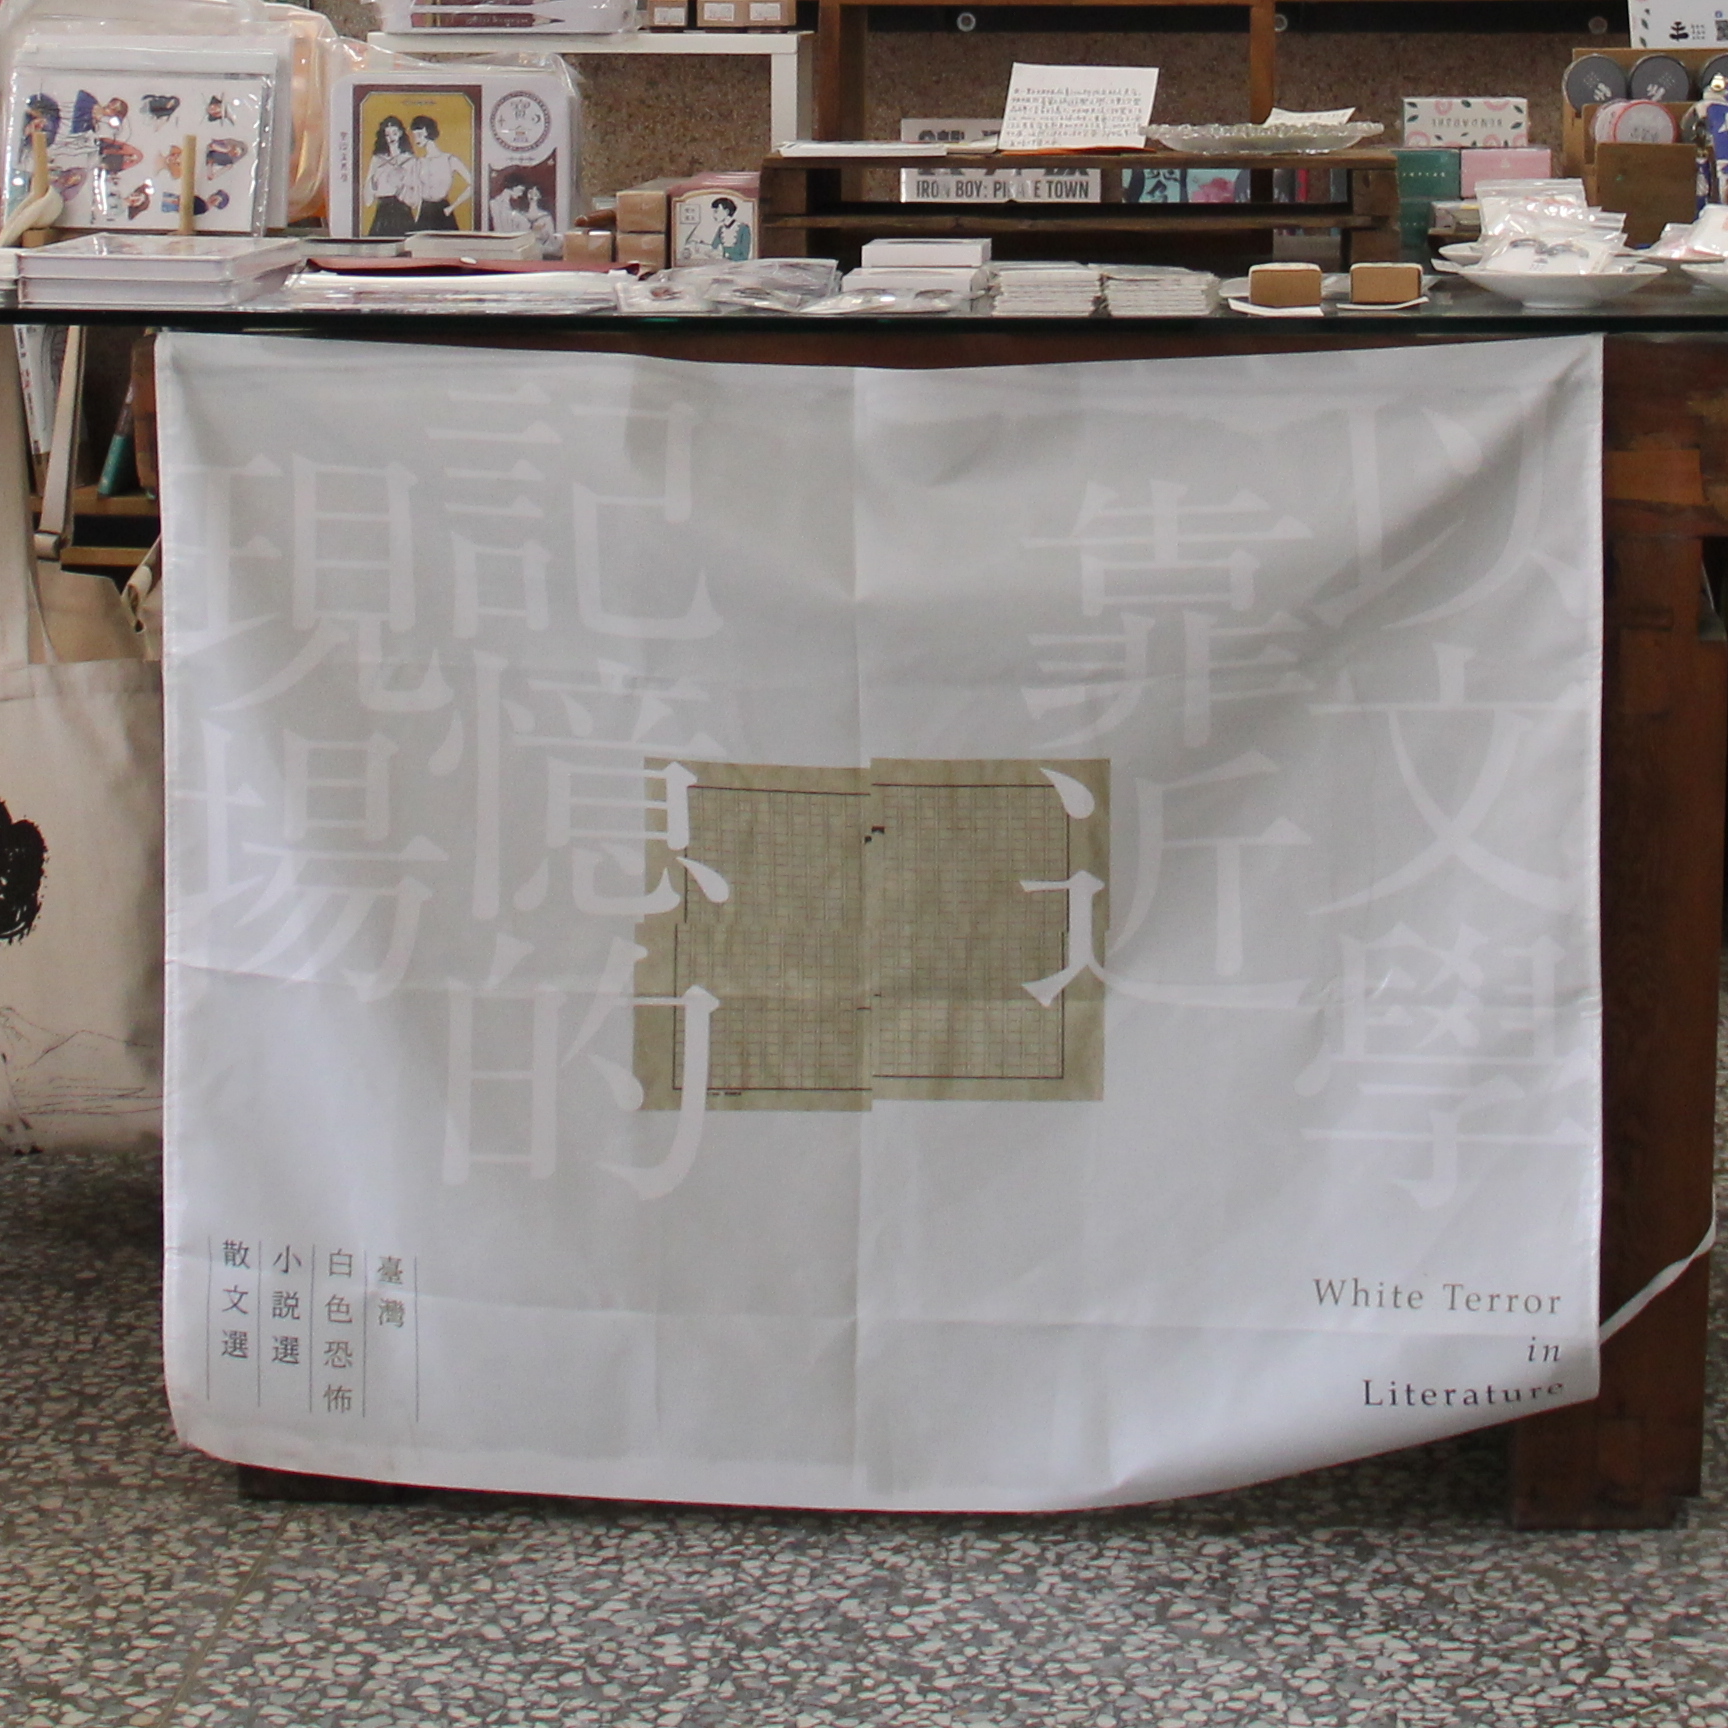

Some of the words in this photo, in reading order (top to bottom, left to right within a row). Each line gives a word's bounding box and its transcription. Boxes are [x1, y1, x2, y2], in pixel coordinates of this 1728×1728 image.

[1046, 180, 1089, 199] TOWN
[1019, 479, 1312, 1014] 靠近
[424, 380, 730, 1203] 記憶的
[221, 1238, 251, 1360] 散文選
[377, 1255, 406, 1329] 臺灣
[1314, 1277, 1424, 1309] White
[1443, 1283, 1561, 1314] Terror
[322, 1247, 354, 1414] 白色恐怖
[1527, 1336, 1561, 1362] in
[1362, 1379, 1564, 1407] Literature
